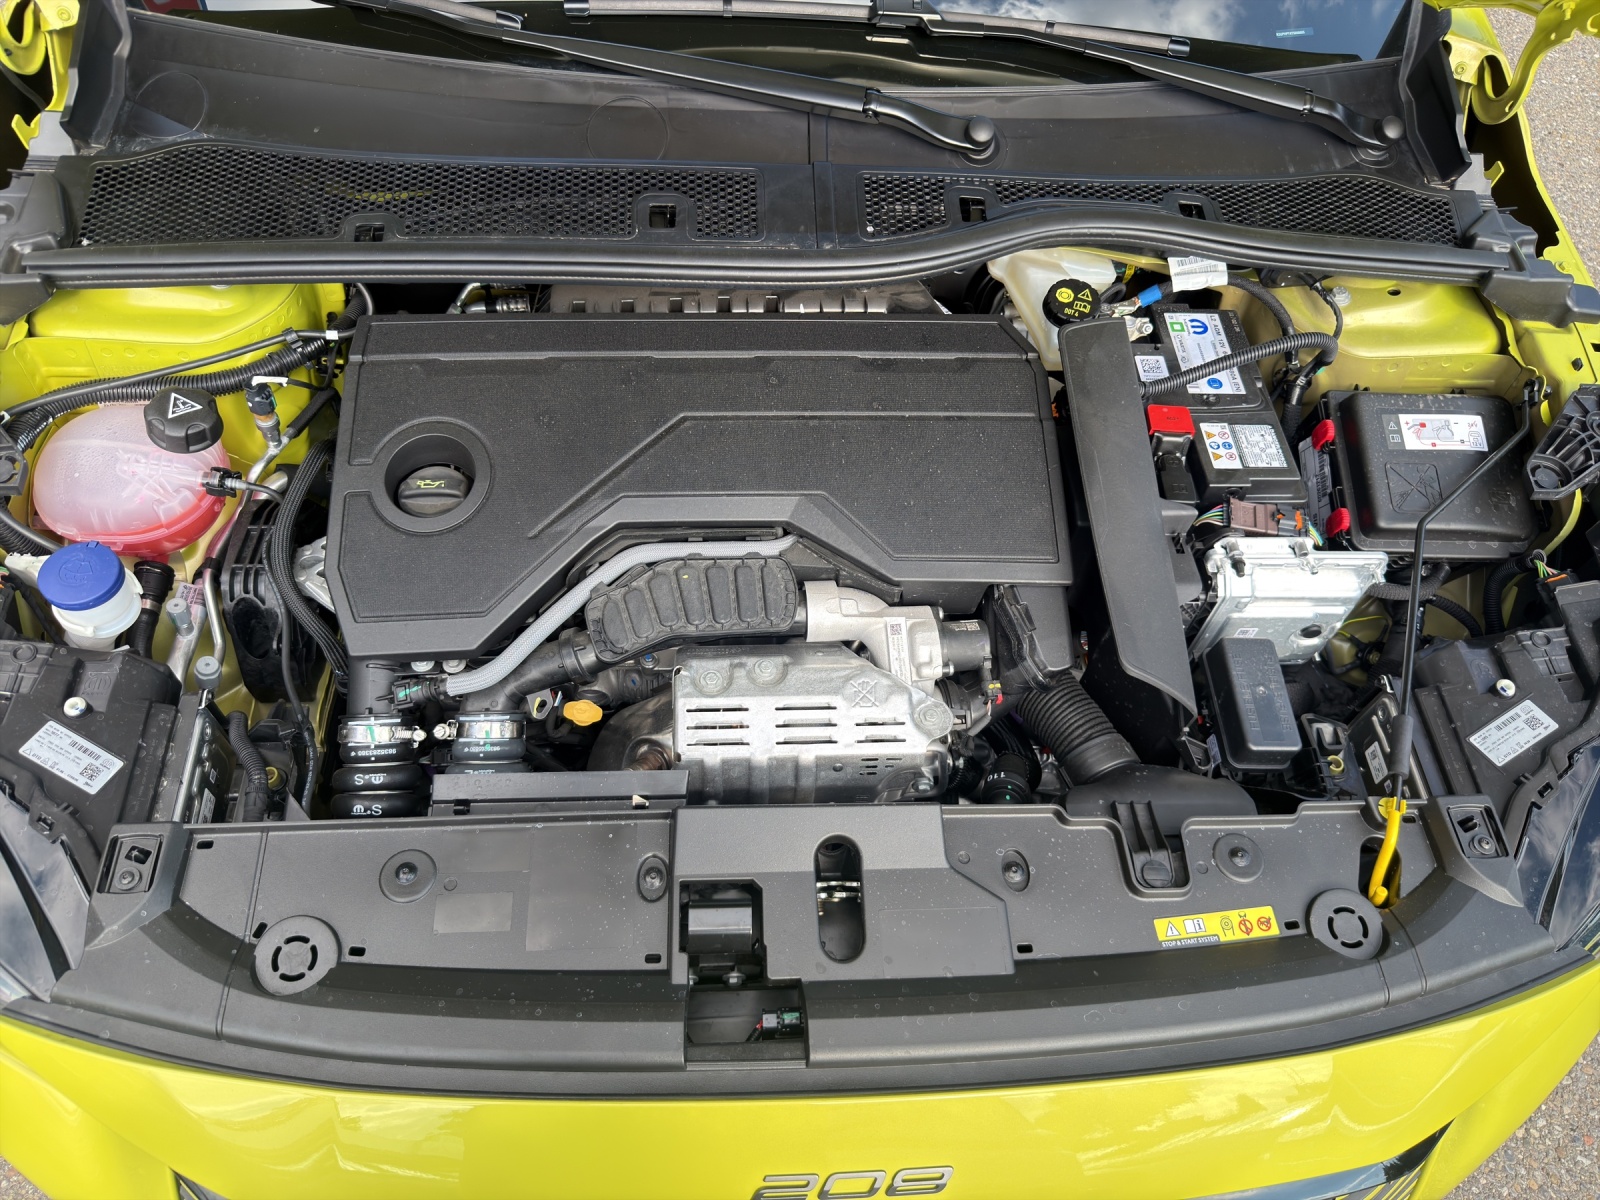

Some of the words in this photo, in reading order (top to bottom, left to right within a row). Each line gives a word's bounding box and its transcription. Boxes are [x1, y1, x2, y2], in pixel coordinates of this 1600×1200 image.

[1064, 307, 1074, 316] DOT
[1213, 323, 1221, 336] AGM
[1217, 338, 1226, 349] 12V
[1232, 381, 1242, 392] (EN)
[354, 773, 364, 785] S
[371, 804, 382, 816] S
[1161, 940, 1177, 948] STOP
[1181, 937, 1198, 945] START
[1197, 935, 1219, 943] SYSTEM
[751, 1165, 954, 1200] 208
